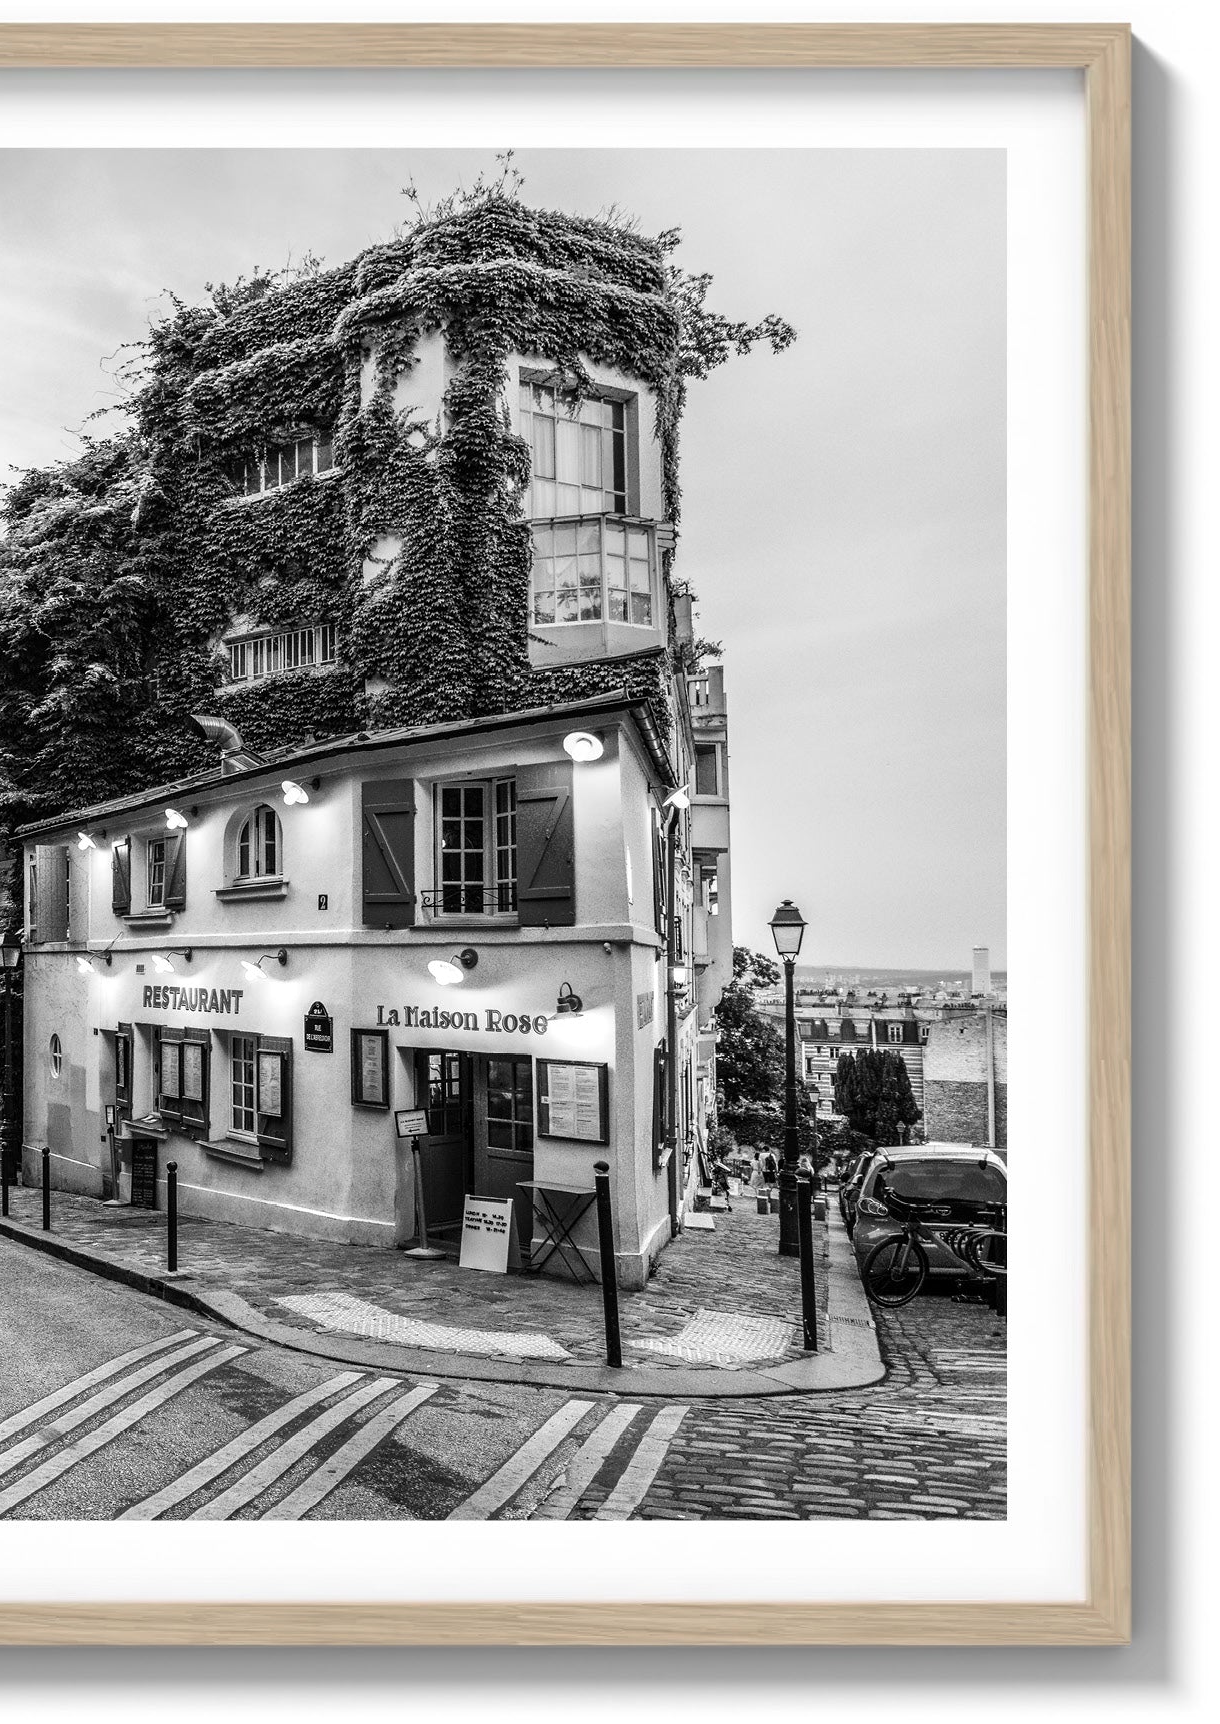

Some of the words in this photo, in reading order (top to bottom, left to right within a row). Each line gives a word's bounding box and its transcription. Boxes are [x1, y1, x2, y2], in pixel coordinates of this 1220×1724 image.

[320, 895, 326, 910] 2
[143, 985, 244, 1014] RESTAURANT
[377, 1005, 400, 1027] La
[404, 1006, 480, 1031] Maison
[484, 1009, 548, 1035] Rose
